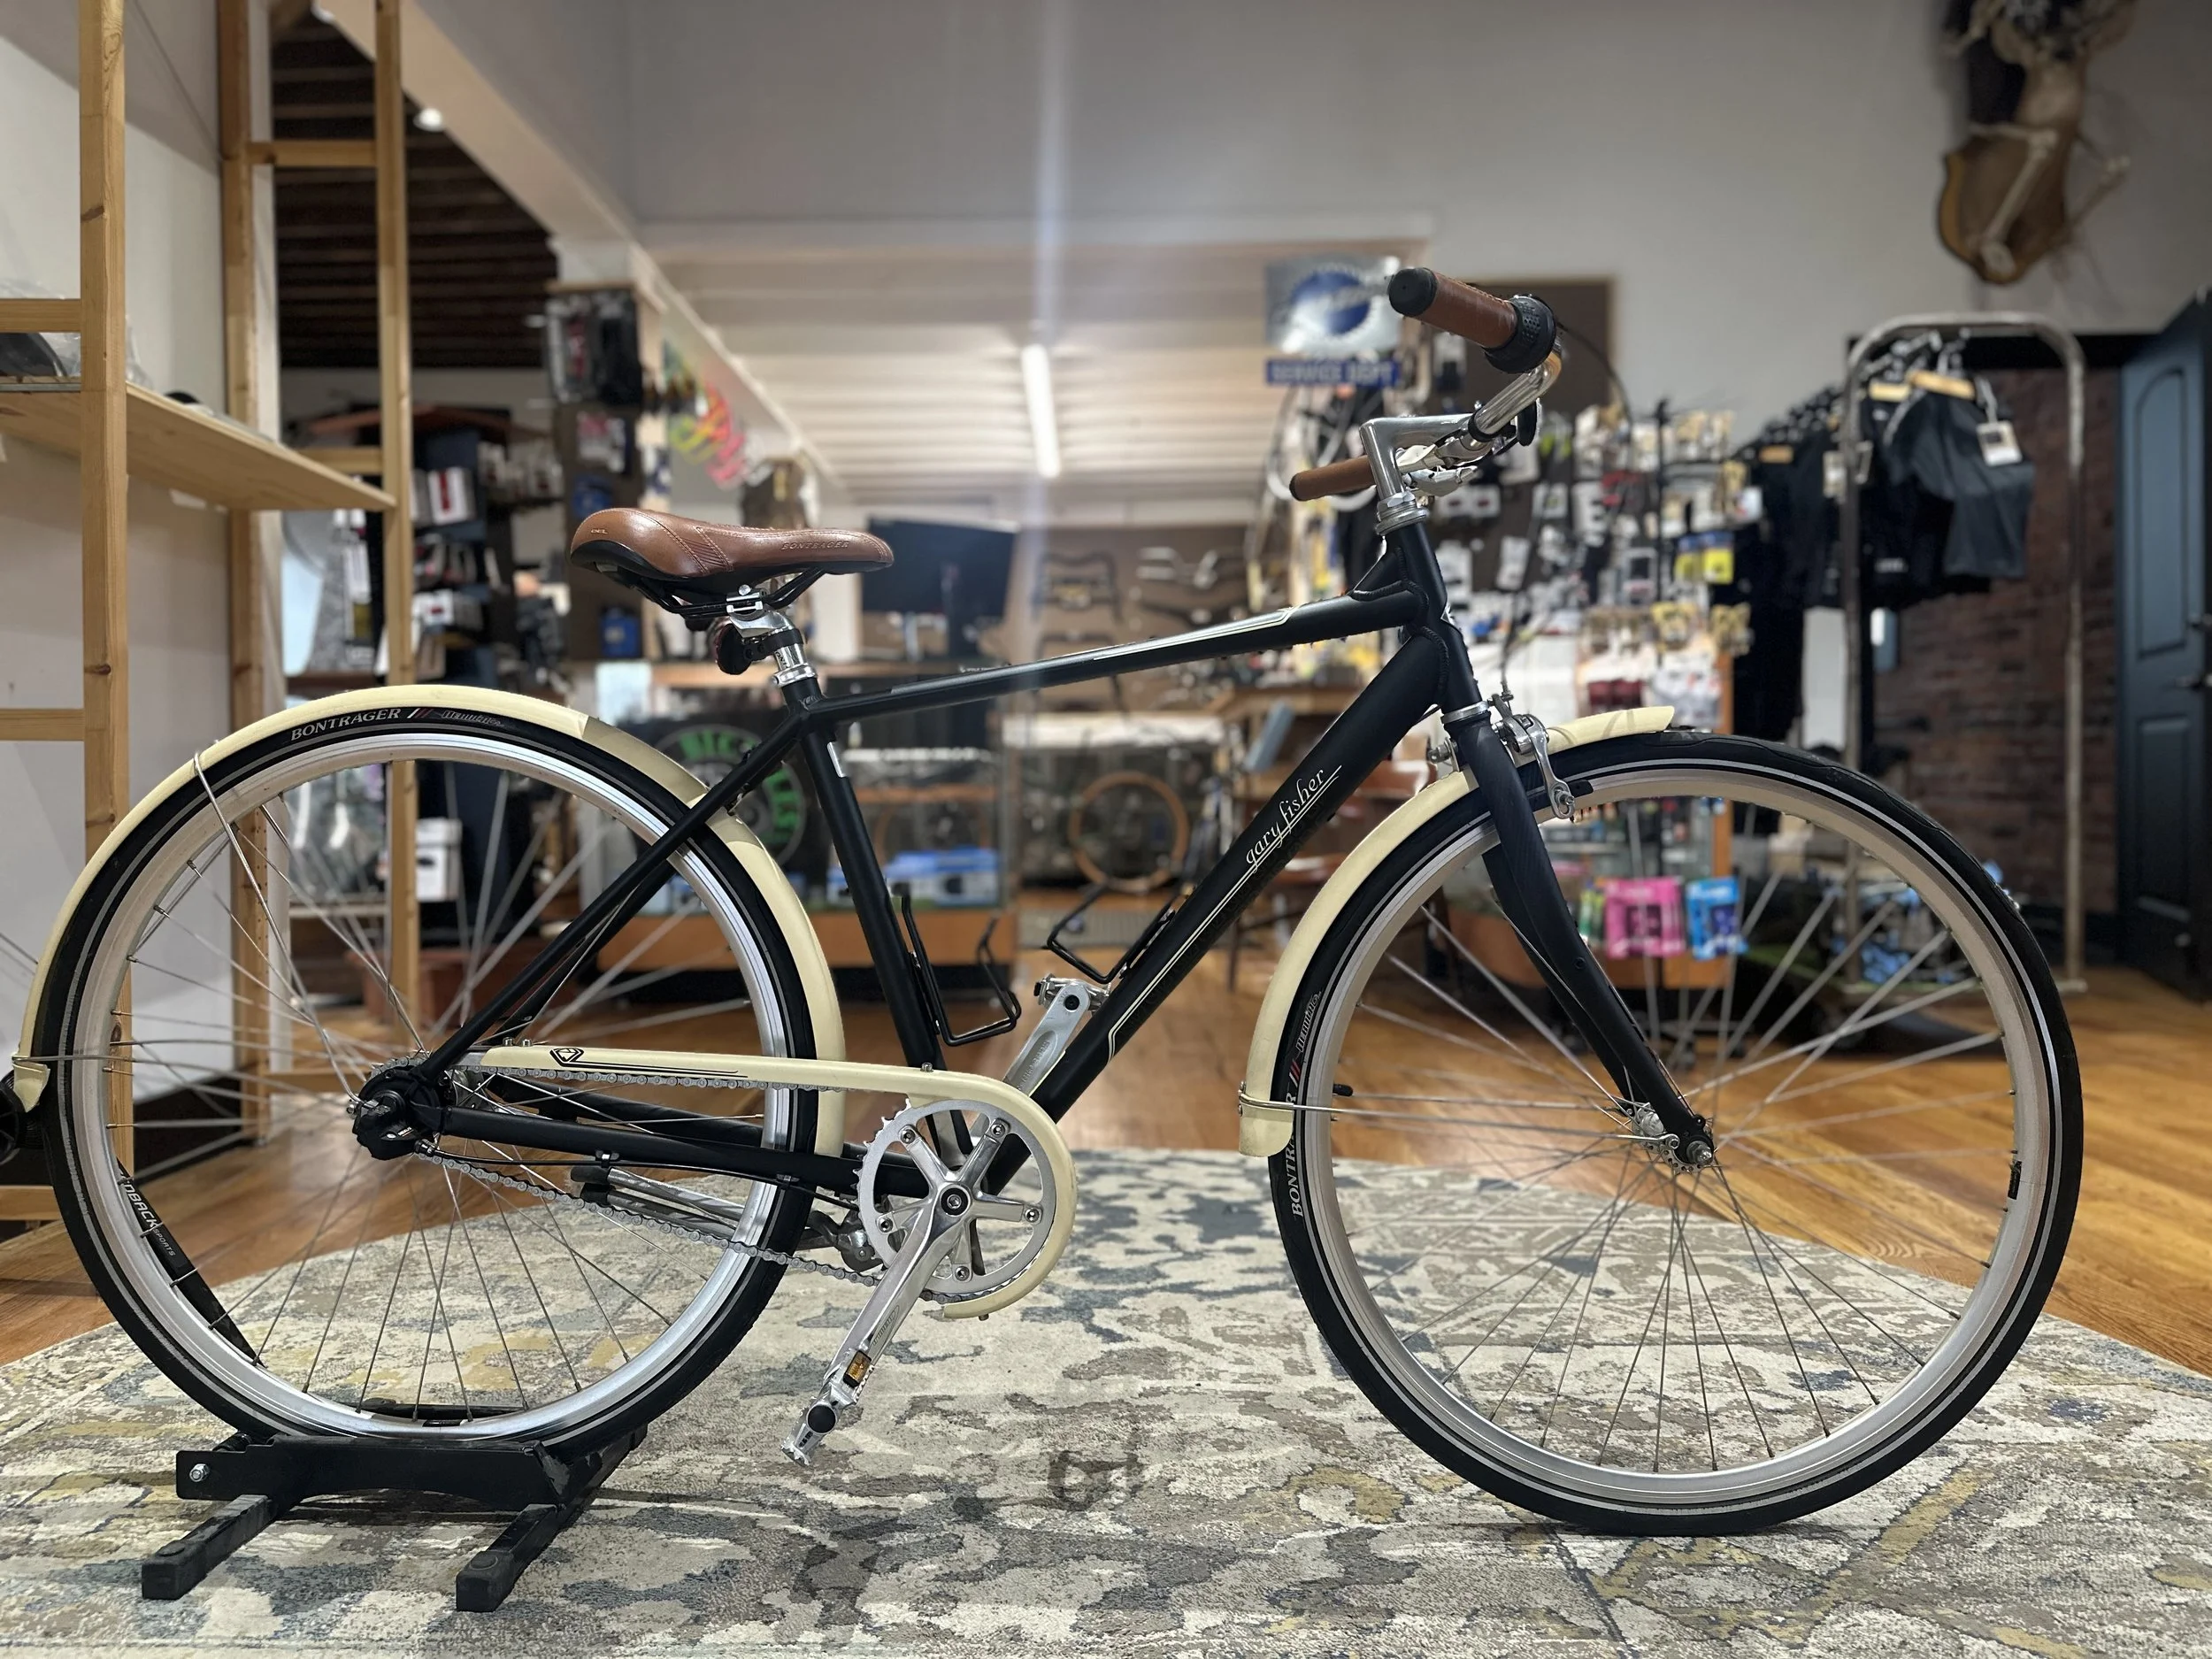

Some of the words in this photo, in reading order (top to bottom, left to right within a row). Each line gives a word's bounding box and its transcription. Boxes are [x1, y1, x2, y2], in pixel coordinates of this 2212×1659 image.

[781, 540, 849, 550] BONTRAGER
[290, 708, 401, 741] BONTRAGER
[1246, 822, 1283, 873] gary
[1279, 769, 1324, 834] fisher
[153, 1228, 176, 1256] SPORTS
